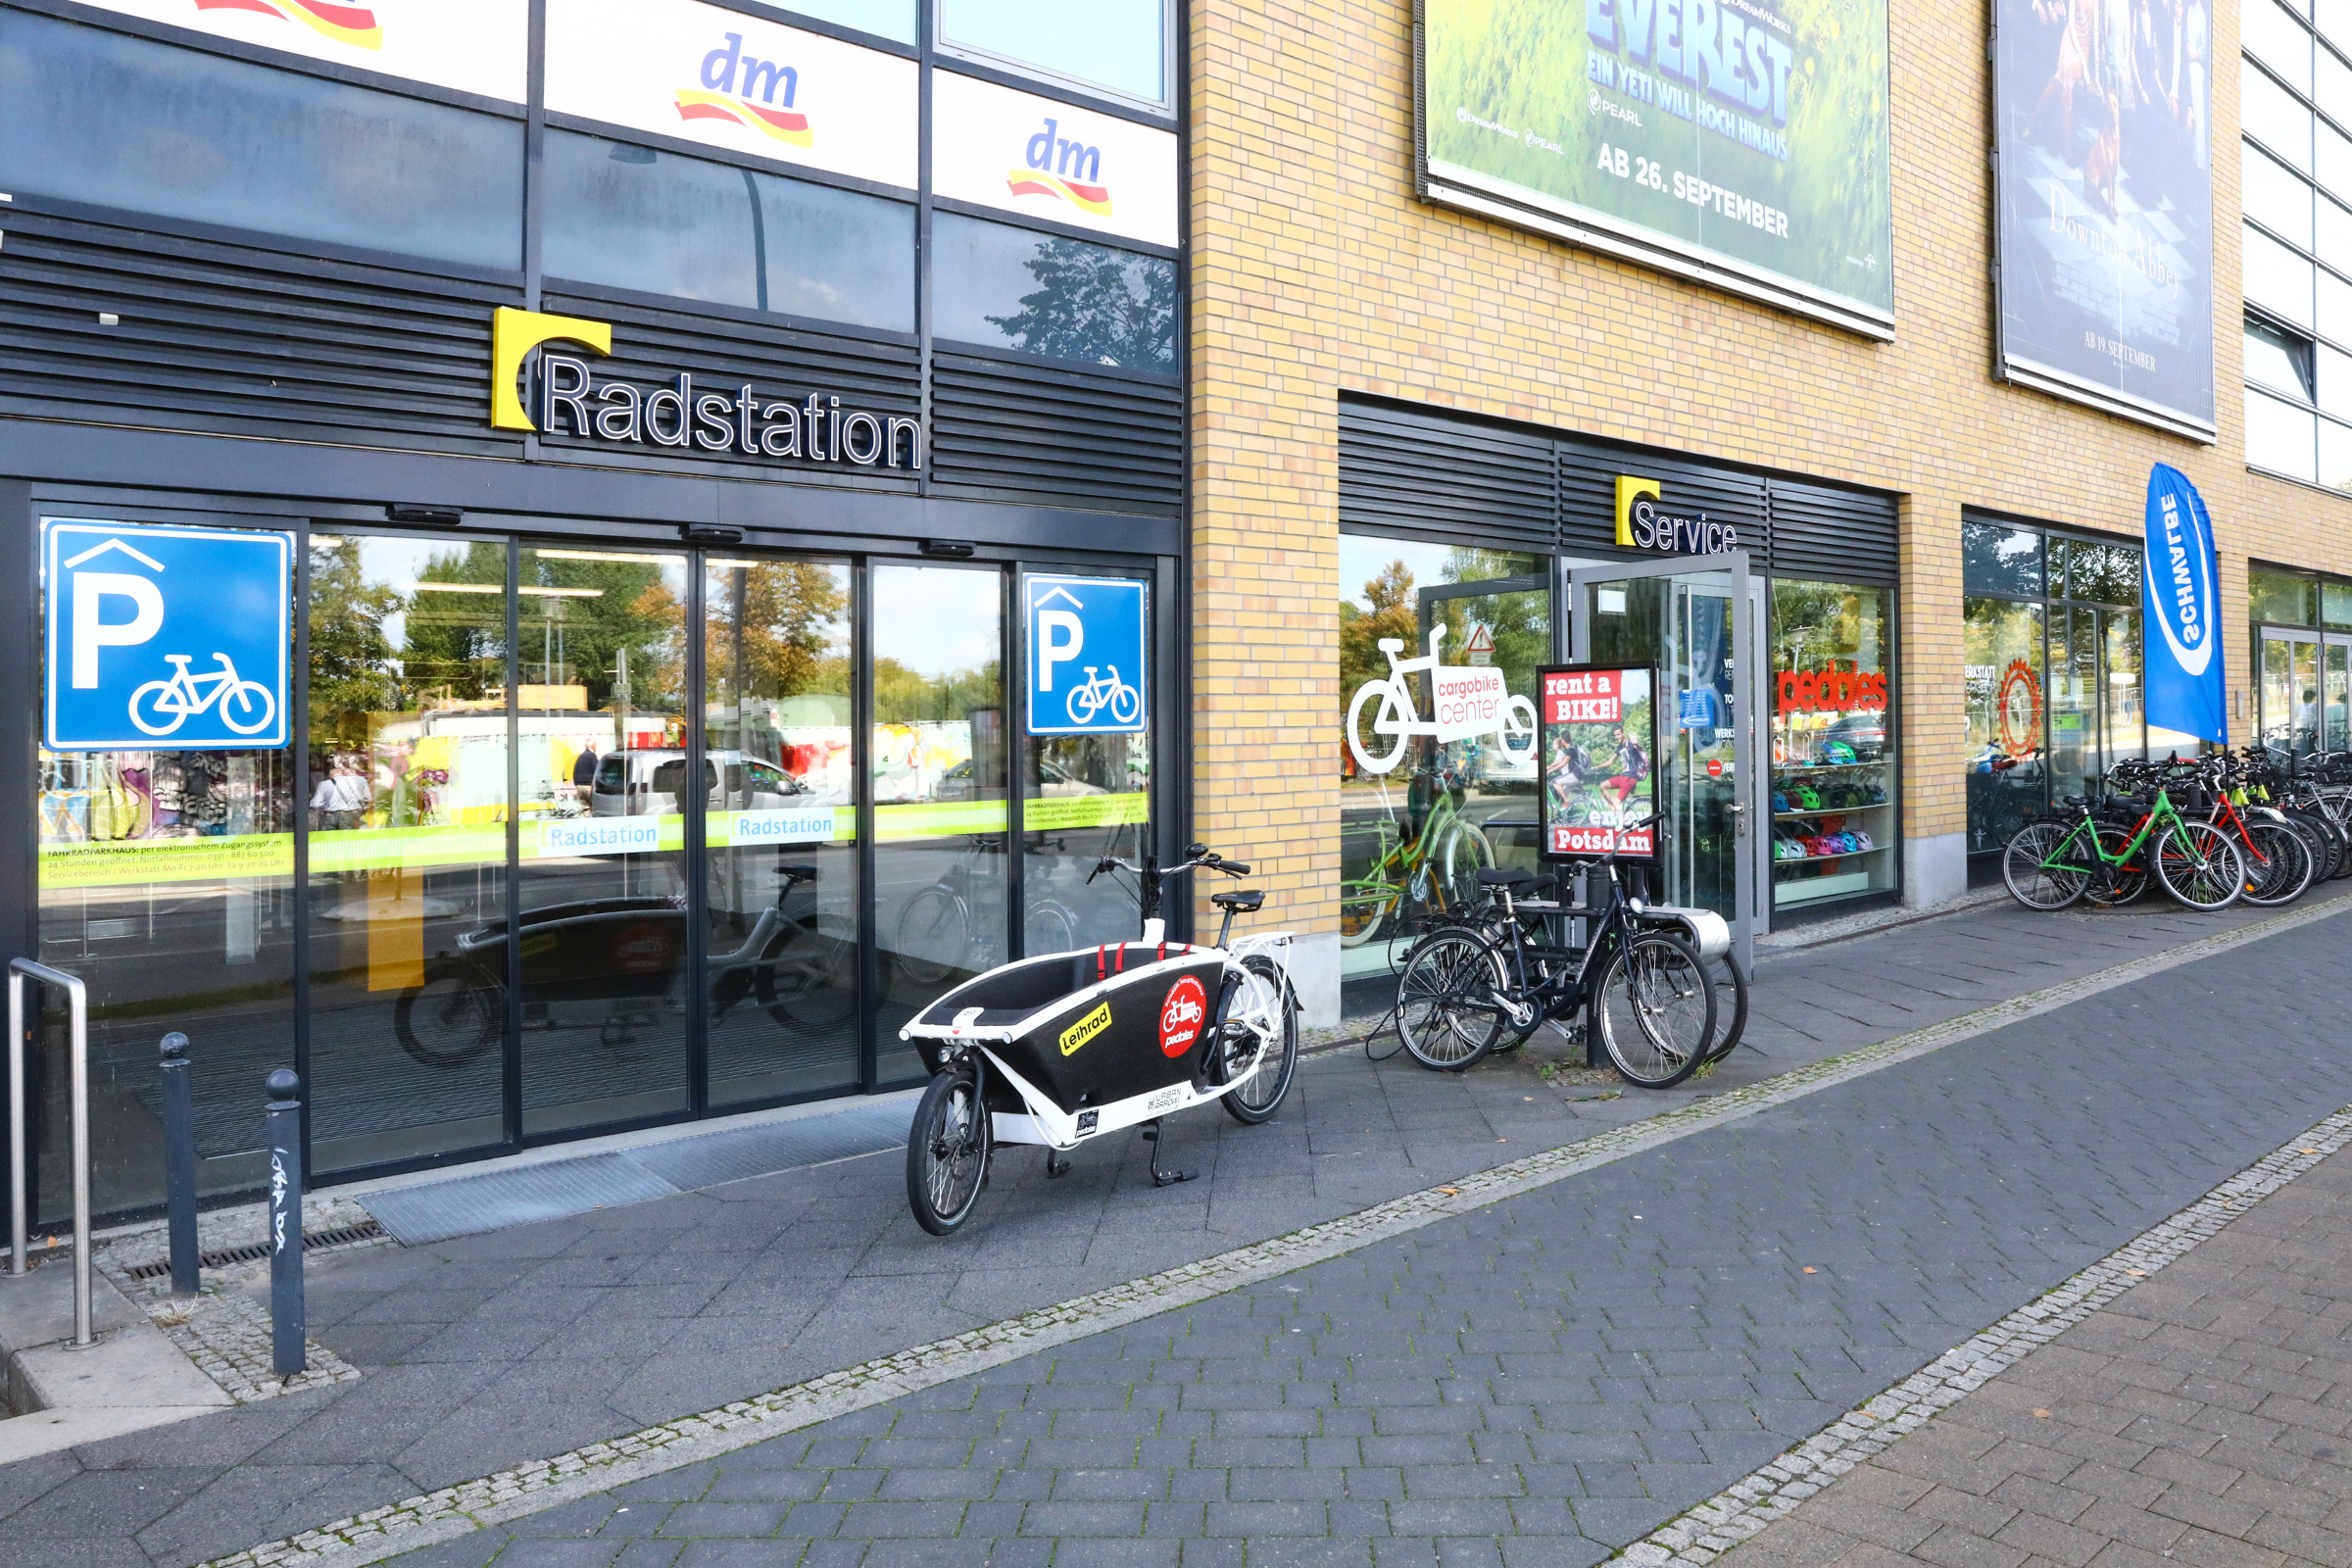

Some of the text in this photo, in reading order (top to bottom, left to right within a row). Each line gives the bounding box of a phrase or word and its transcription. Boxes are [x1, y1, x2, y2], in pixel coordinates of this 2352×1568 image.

[701, 31, 798, 109] dm
[1588, 49, 1788, 163] EIN YETI WILL HOCH HINAUS
[1601, 100, 1642, 127] PEARL
[1026, 118, 1101, 183] dm
[1534, 136, 1564, 155] PEARL
[1597, 143, 1788, 239] AB 26. SEPTEMBER
[2048, 183, 2180, 298] Downton Abbey
[2084, 331, 2095, 348] AB
[2097, 337, 2107, 353] 19.
[2109, 339, 2156, 372] SEPTEMBER
[542, 354, 921, 470] Radstation
[1635, 502, 1738, 555] Service
[73, 571, 165, 689] P
[1039, 610, 1083, 692] P
[1546, 672, 1611, 696] rent a
[1964, 665, 1996, 678] ERKSTATT
[1439, 676, 1498, 699] cargobike
[1778, 660, 1887, 725] pedales
[1441, 694, 1499, 724] center
[1556, 697, 1618, 721] BIKE!
[740, 816, 832, 835] Radstation
[1590, 809, 1650, 831] enjoy
[551, 825, 657, 847] Radstation
[1558, 829, 1650, 852] Potsdam
[47, 847, 139, 858] FAHRRADPARKHAUS:
[157, 843, 219, 853] elektronischem
[221, 841, 282, 850] Zugangssystem
[47, 866, 110, 878] Servicebereich
[118, 864, 160, 874] Werkstatt
[61, 858, 96, 868] Stunden
[1062, 1007, 1107, 1051] Leihrad
[1165, 1030, 1194, 1049] pedales
[1155, 1088, 1181, 1102] URBAN
